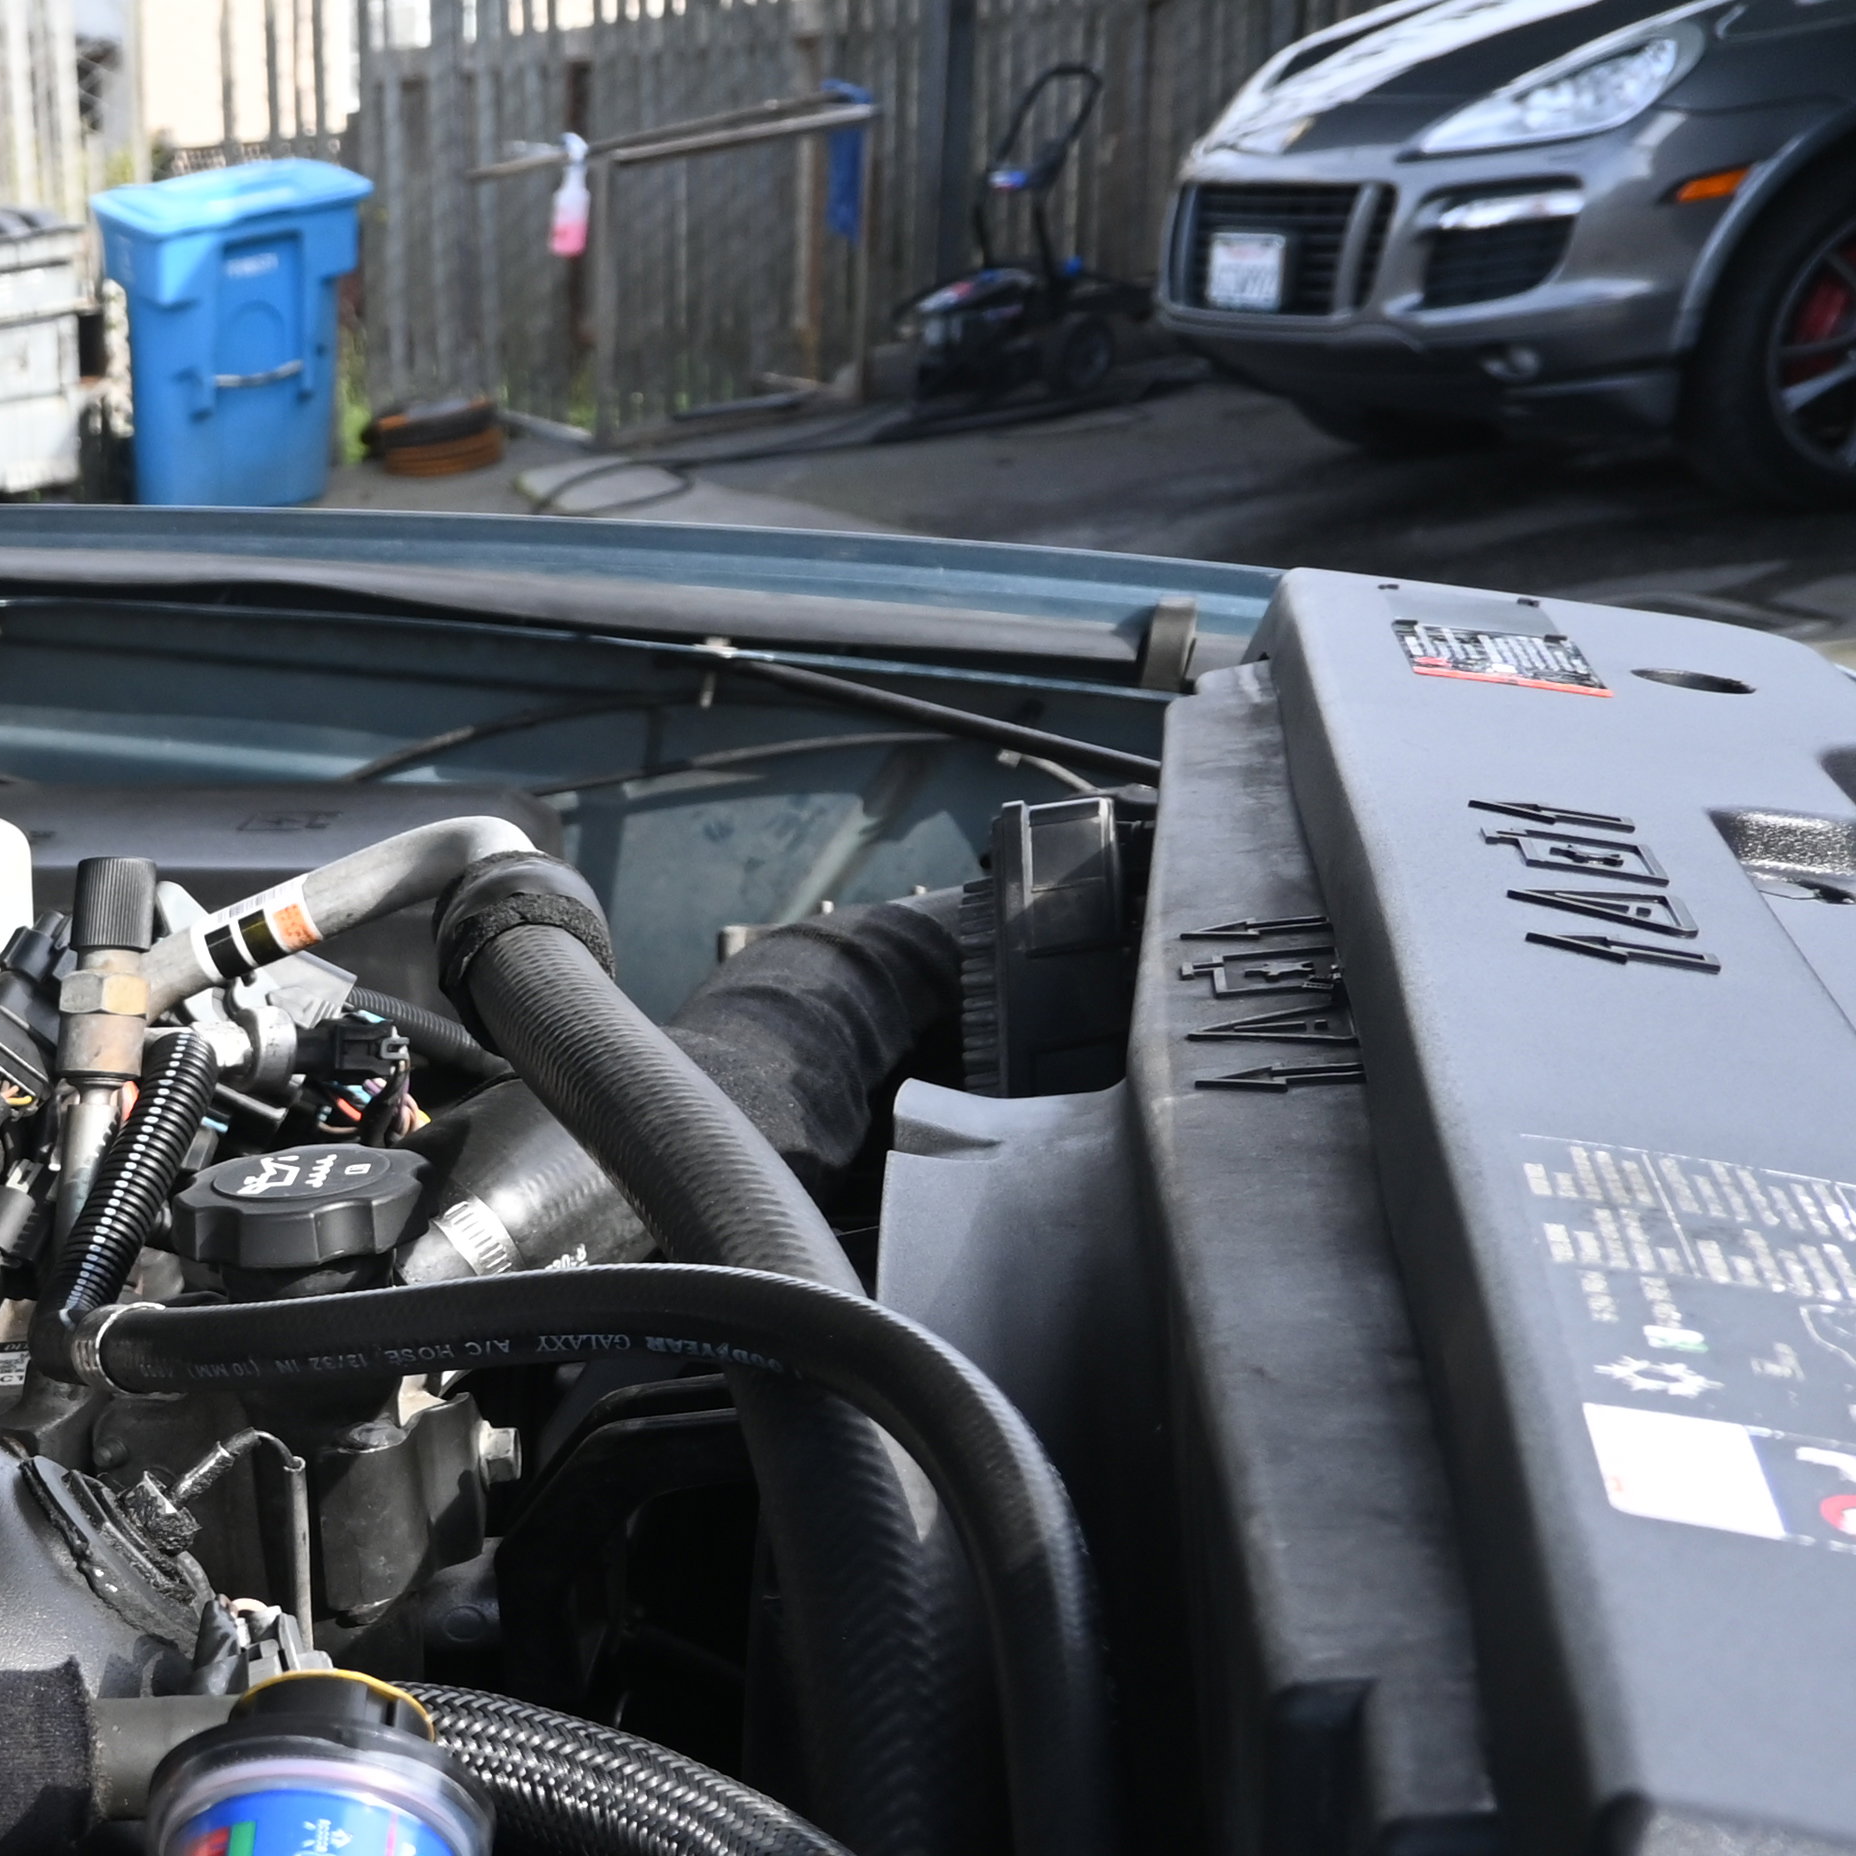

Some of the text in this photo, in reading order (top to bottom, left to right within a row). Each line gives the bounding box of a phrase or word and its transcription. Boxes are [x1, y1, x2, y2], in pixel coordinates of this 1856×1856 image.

[464, 1338, 511, 1357] A/C
[535, 1333, 631, 1353] GALAXY
[383, 1343, 452, 1364] HOSE
[645, 1334, 798, 1378] OODYEAR
[274, 1358, 300, 1374] IN
